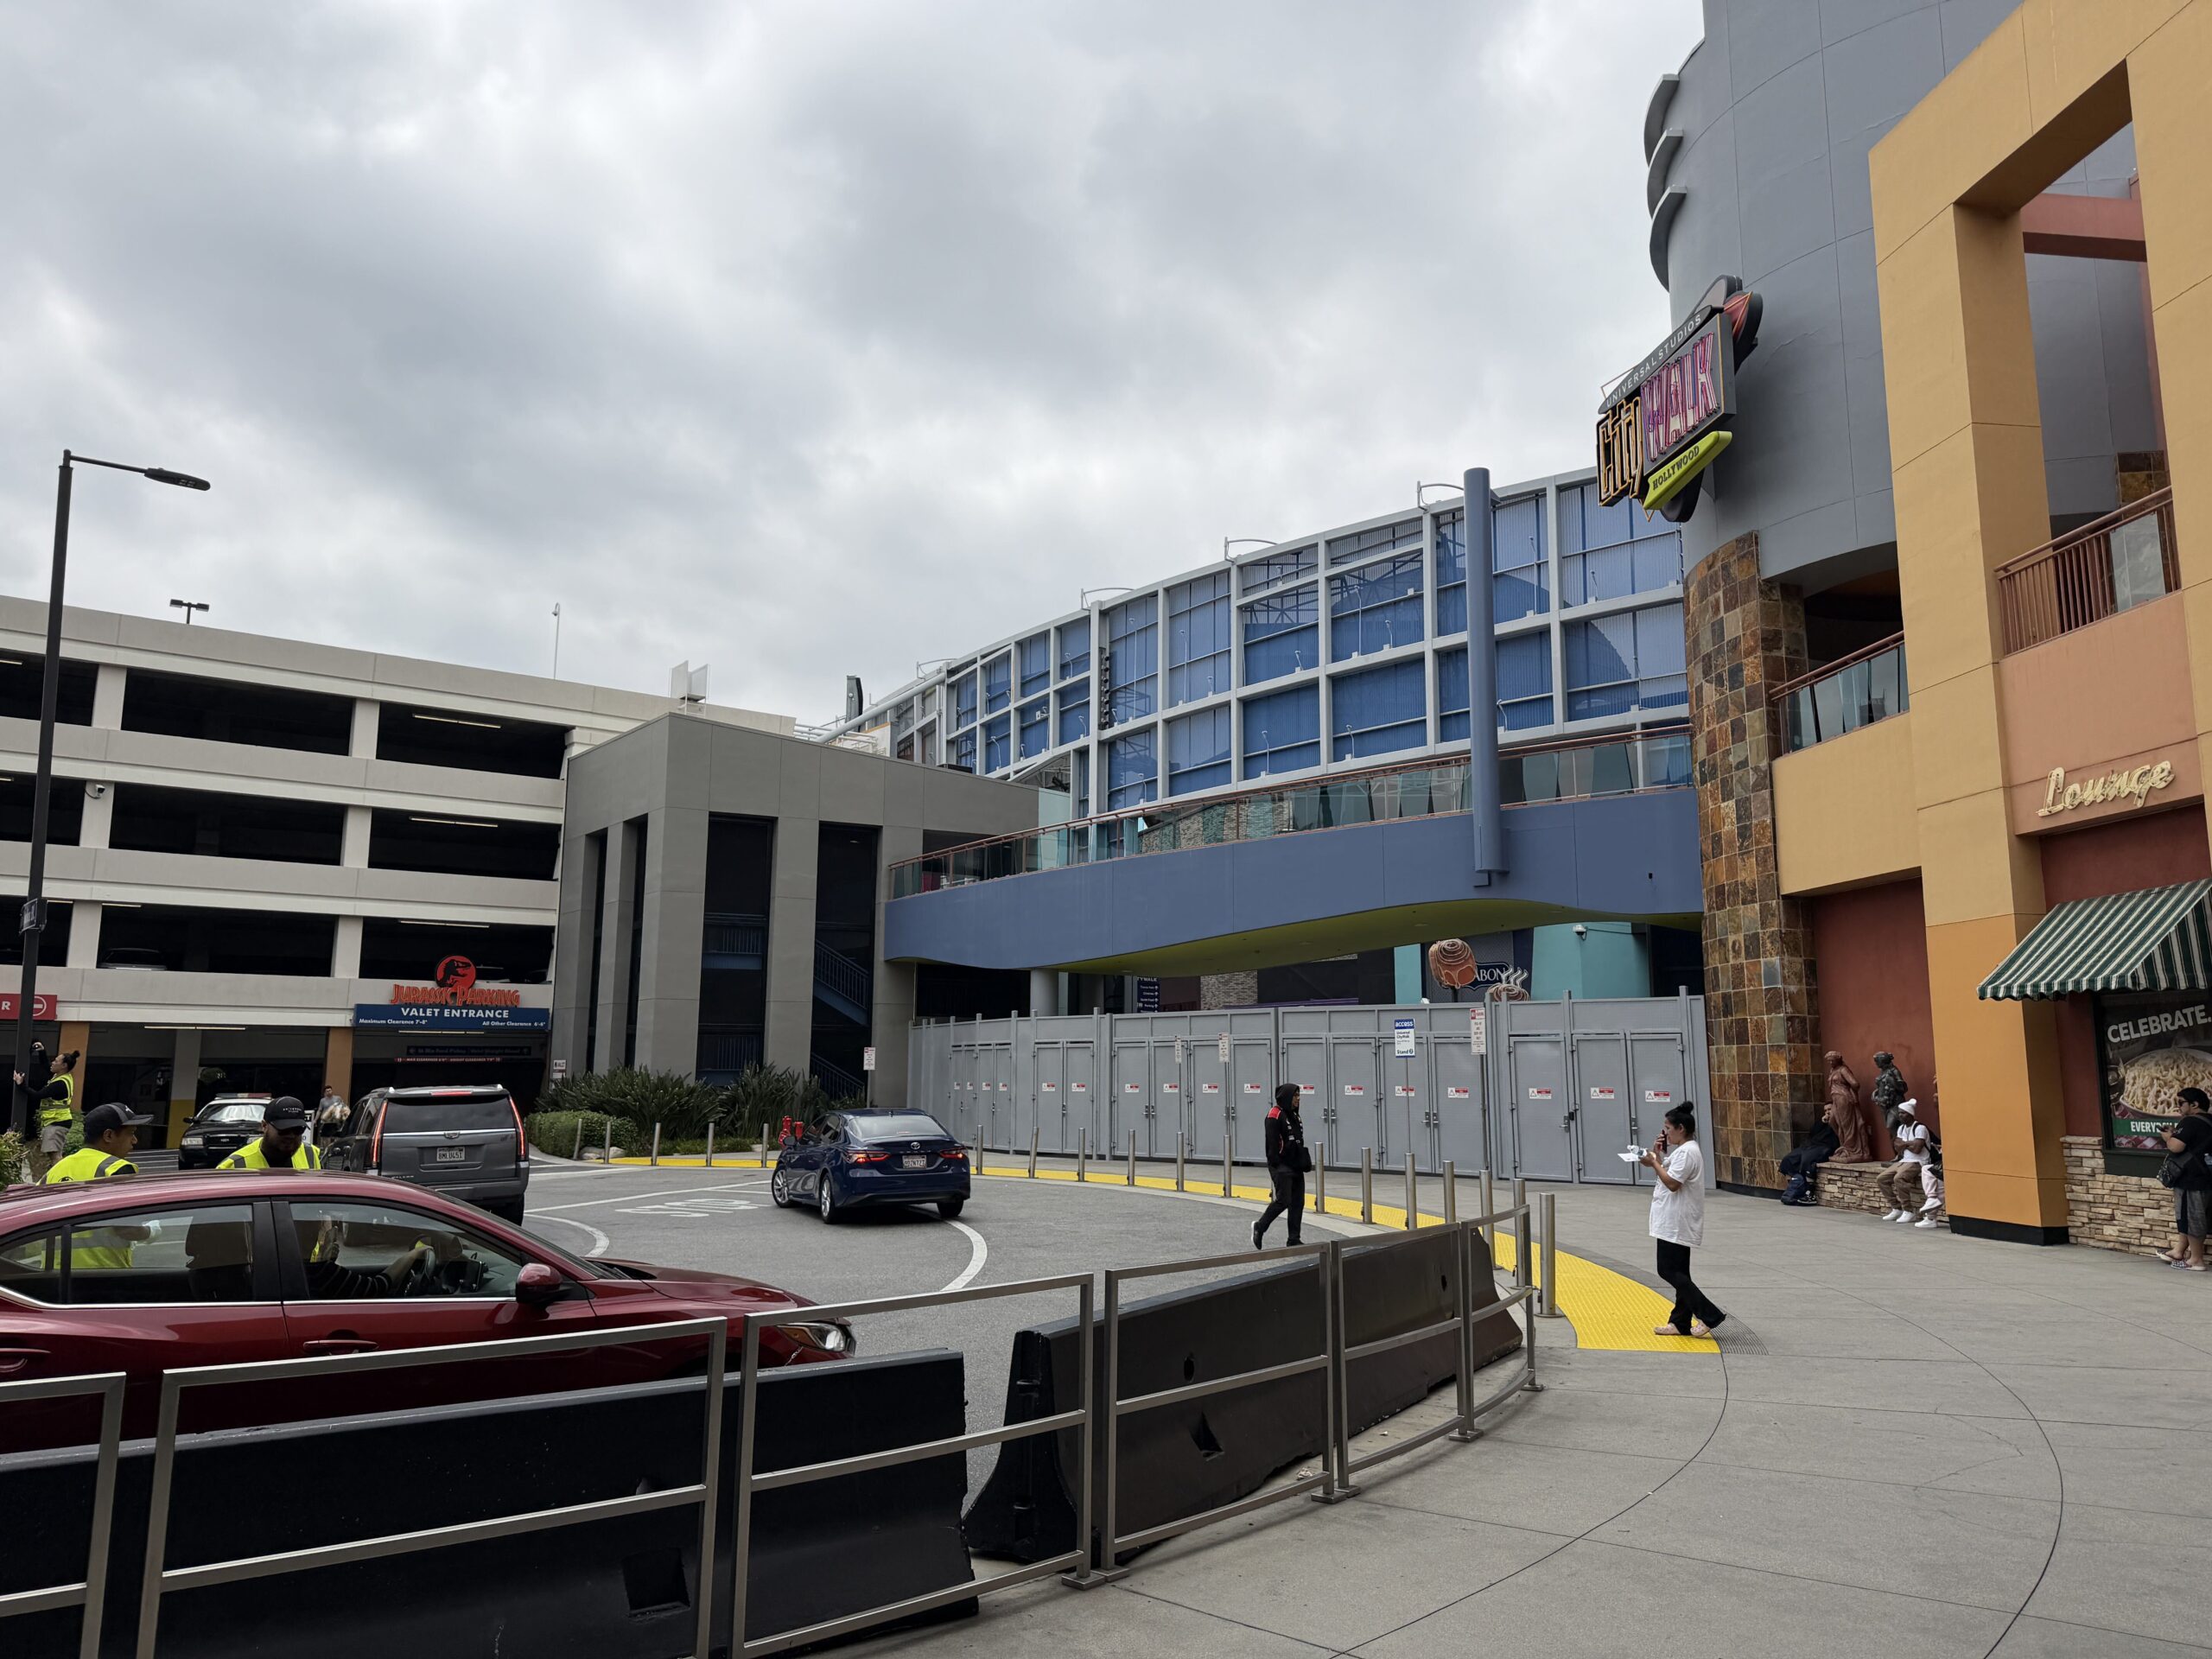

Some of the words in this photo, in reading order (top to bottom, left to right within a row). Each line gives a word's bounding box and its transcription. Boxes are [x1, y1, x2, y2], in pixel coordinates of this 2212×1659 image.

[1605, 357, 1657, 409] UNIVERSAL
[1657, 313, 1702, 360] STUDIOS
[1640, 331, 1719, 463] WALK
[1652, 445, 1700, 490] HOLLYWOOD
[2035, 760, 2175, 817] Lounge
[390, 983, 451, 1005] JURASSIC
[457, 985, 520, 1007] PARKING
[401, 1007, 440, 1016] VALET
[444, 1008, 509, 1018] ENTRANCE
[2107, 1004, 2212, 1043] CELEBRATE.
[2130, 1121, 2172, 1133] EVERYD
